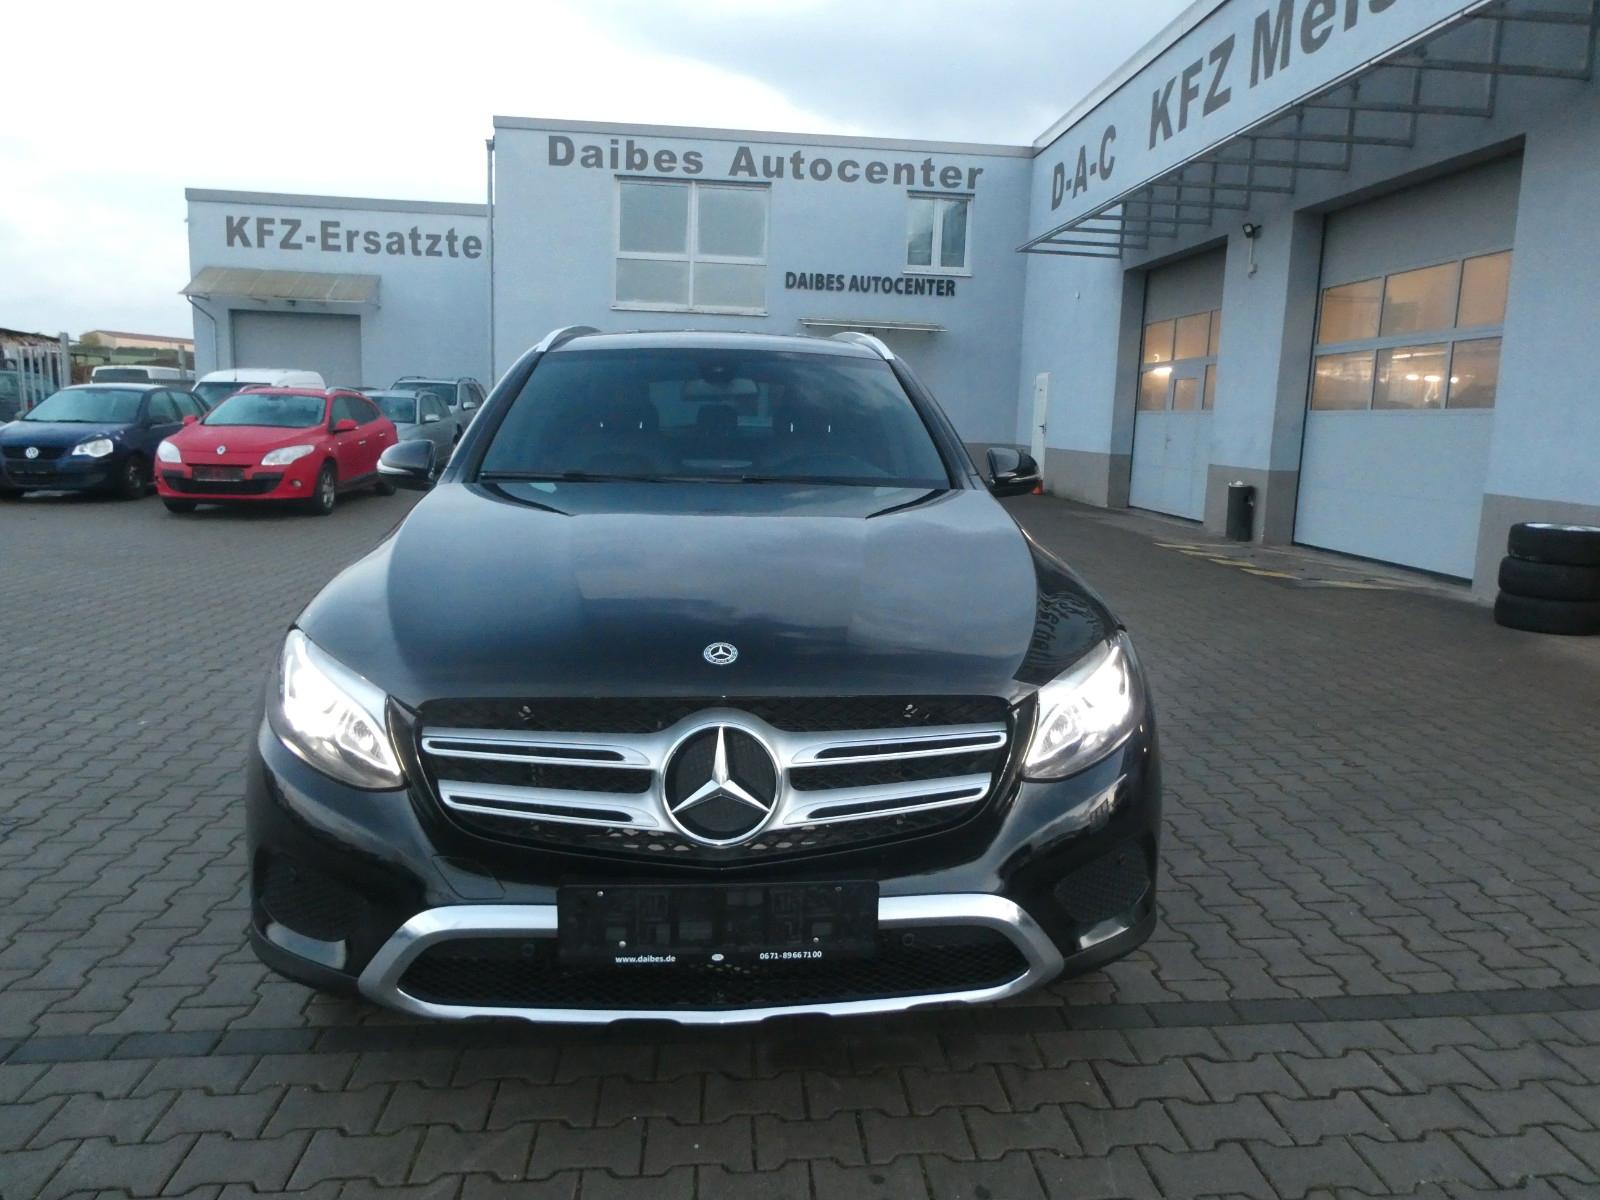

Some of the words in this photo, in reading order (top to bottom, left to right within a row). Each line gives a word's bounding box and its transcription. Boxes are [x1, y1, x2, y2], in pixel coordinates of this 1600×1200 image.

[1052, 125, 1116, 211] D-A-C
[1149, 34, 1236, 150] KFZ
[1249, 0, 1397, 88] Me
[548, 135, 704, 174] Daibes
[728, 146, 985, 190] Autocenter
[225, 215, 483, 260] KFZ-Ersatzte
[784, 271, 845, 292] DAIBES
[848, 274, 956, 298] AUTOCENTER
[615, 953, 677, 964] www.daibes.de
